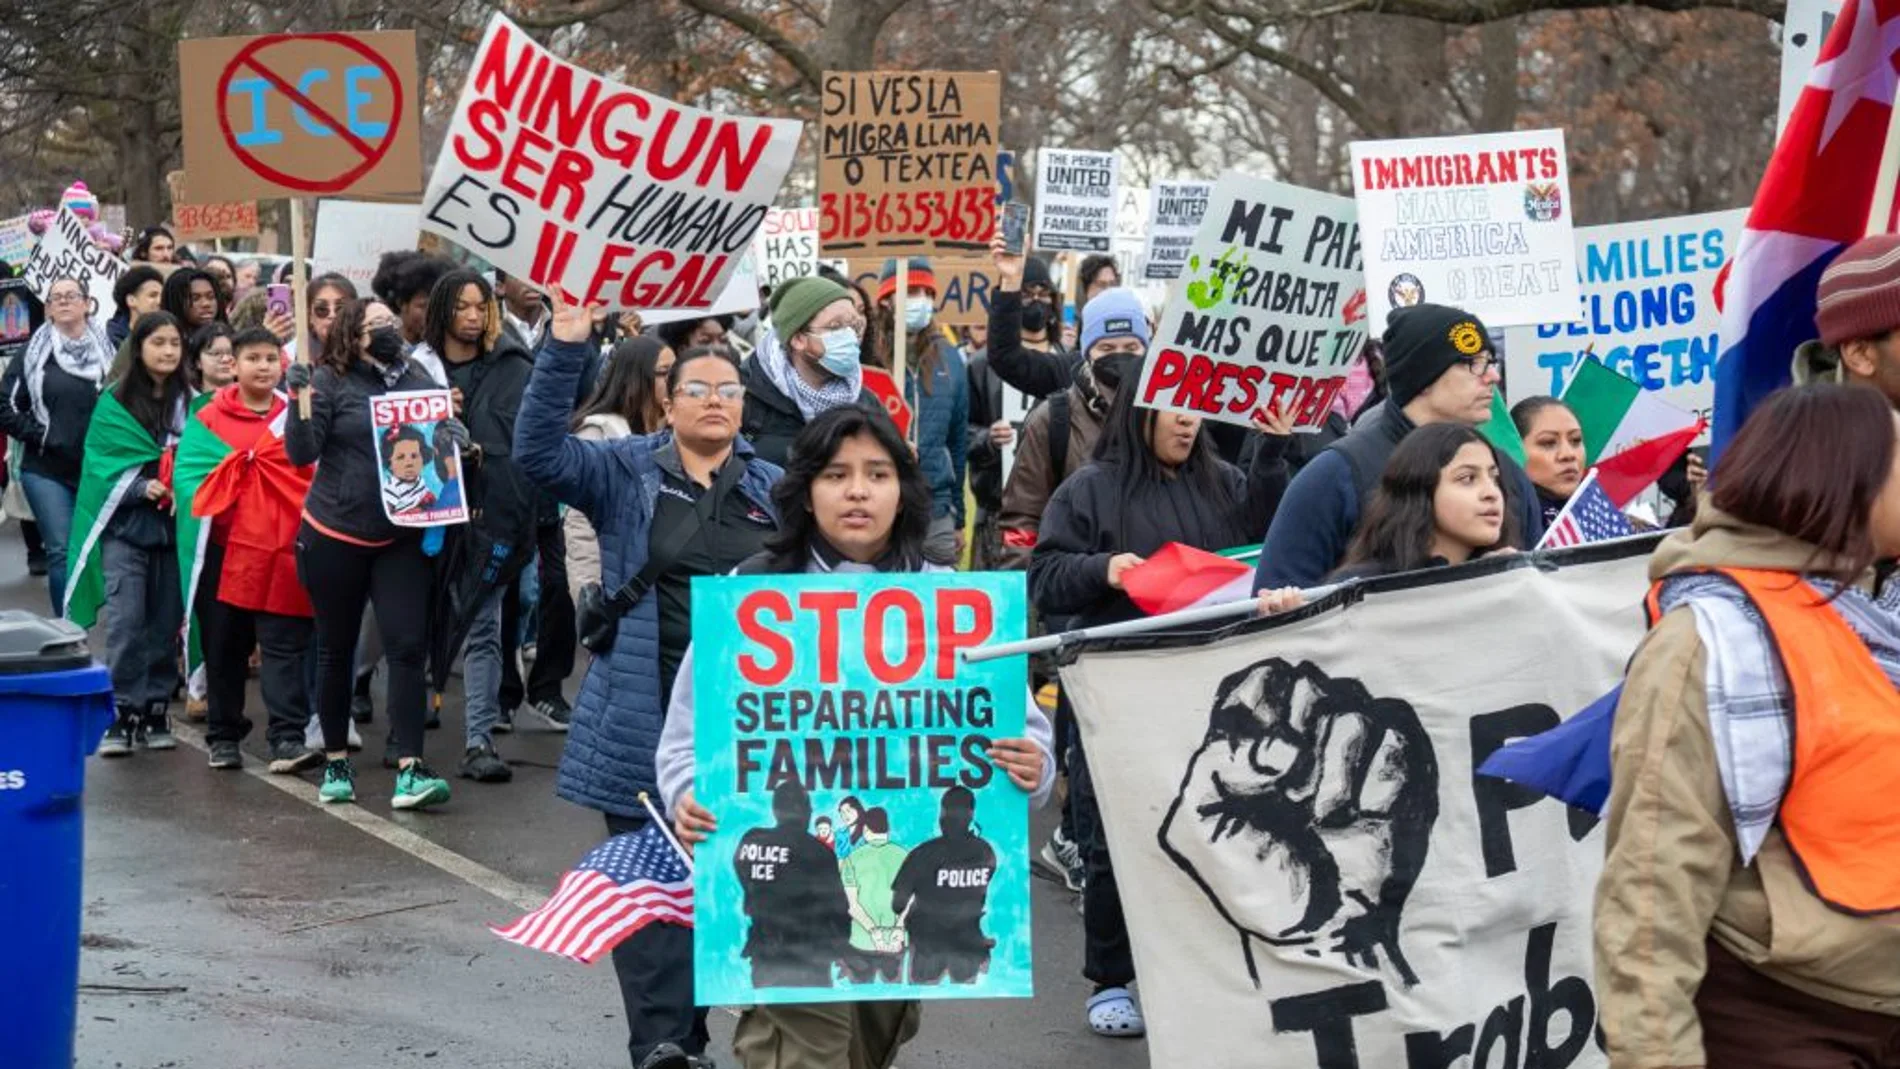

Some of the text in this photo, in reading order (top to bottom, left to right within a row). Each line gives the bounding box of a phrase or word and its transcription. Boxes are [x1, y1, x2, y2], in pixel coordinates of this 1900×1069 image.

[228, 65, 388, 146] ICE
[475, 24, 773, 191] NINGUN
[823, 76, 855, 116] SI
[824, 121, 992, 155] MIGRA LLAMA
[453, 100, 769, 254] SER HUMANO
[844, 153, 991, 186] O TEXTEA
[1047, 153, 1112, 168] THE PEOPLE
[1047, 166, 1111, 187] UNITED
[1361, 147, 1558, 190] IMMIGRANTS
[1157, 197, 1208, 216] UNITED
[1159, 184, 1177, 197] THE
[1394, 187, 1491, 226] MAKE
[1043, 217, 1109, 233] FAMILIES!
[1044, 204, 1109, 218] IMMIGRANT
[1220, 199, 1295, 256] MI
[427, 174, 728, 309] ES ILEGAL
[765, 236, 813, 259] HAS
[1380, 222, 1530, 262] AMERICA
[1577, 228, 1725, 285] MILIES
[1210, 259, 1340, 320] TRABAJA
[1446, 260, 1562, 301] GREAT
[1173, 311, 1363, 369] MAS QUE TU
[375, 397, 447, 424] STOP
[736, 587, 994, 687] STOP
[735, 686, 994, 734] SEPARATING
[736, 733, 994, 794] FAMILIES
[739, 843, 790, 864] POLICE
[751, 863, 775, 881] ICE
[936, 867, 990, 888] POLICE
